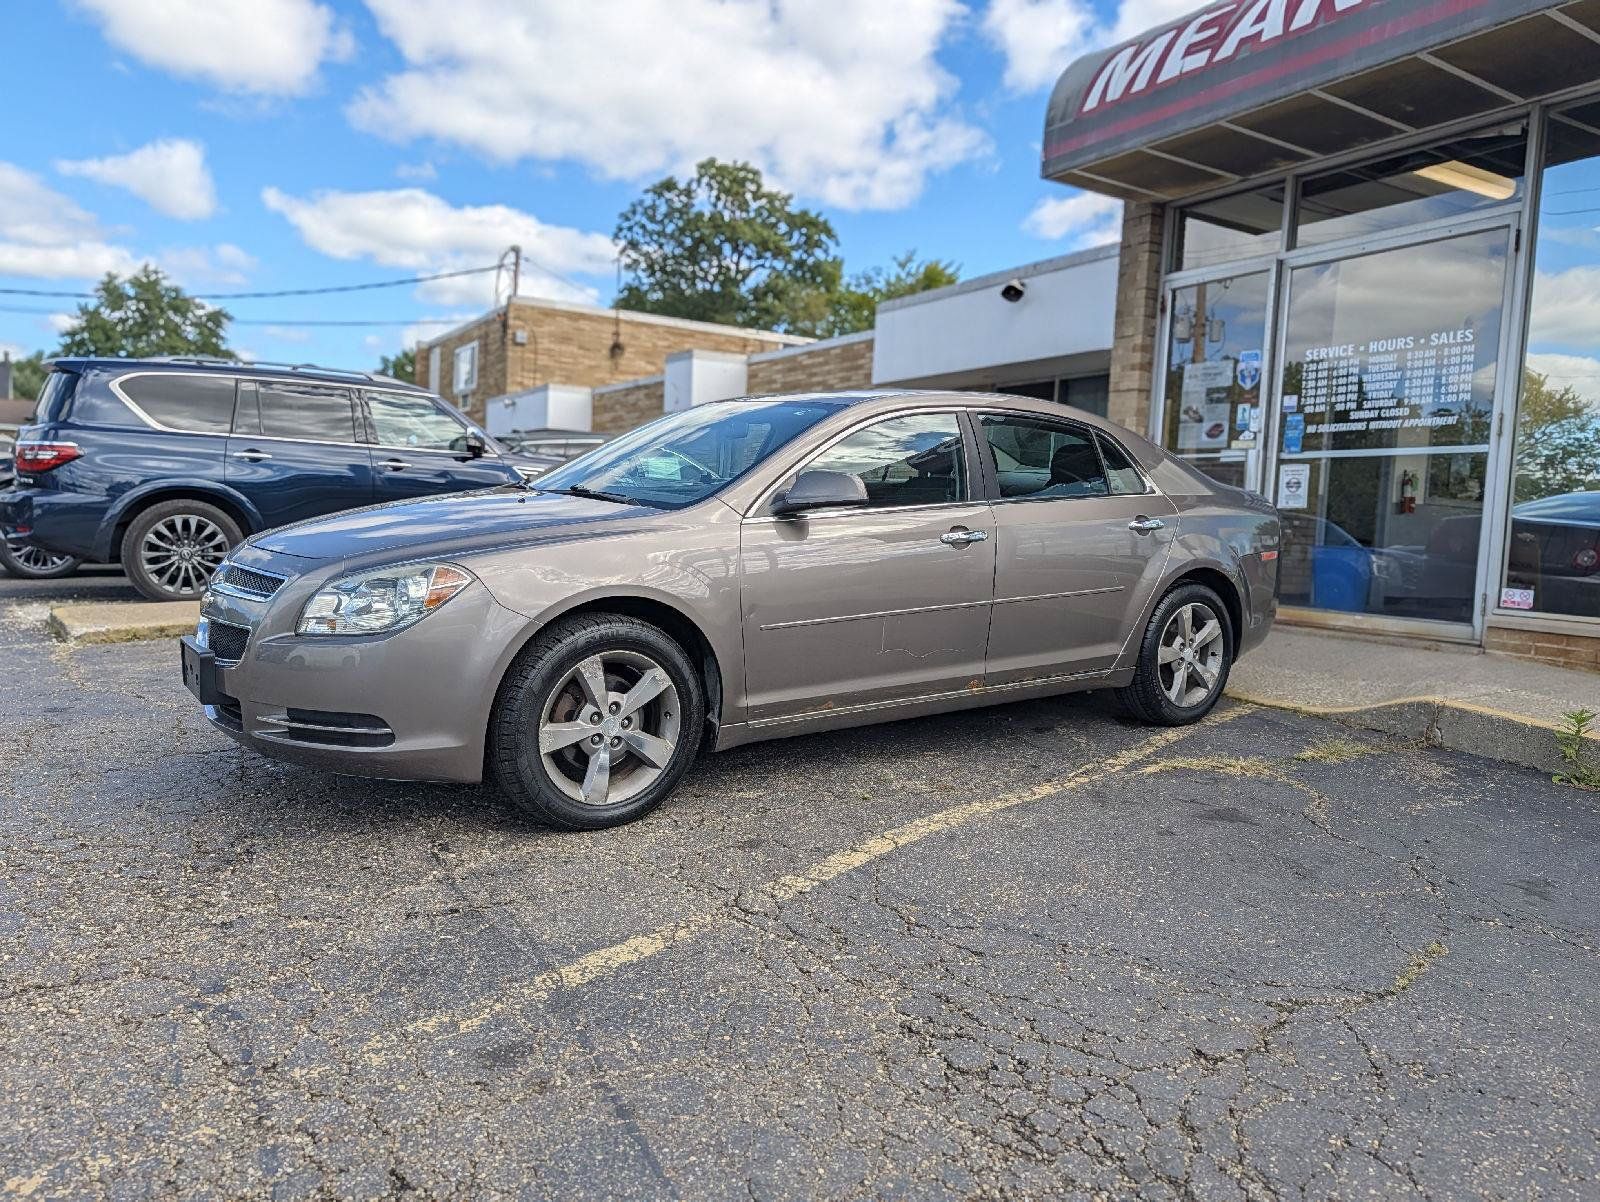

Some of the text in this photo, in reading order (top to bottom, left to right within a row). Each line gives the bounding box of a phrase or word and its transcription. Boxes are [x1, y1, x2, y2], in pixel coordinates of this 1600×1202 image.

[1305, 329, 1474, 361] SERVICE HOURS SALES
[1368, 353, 1398, 365] MONDAY
[1424, 348, 1436, 358] AM
[1462, 344, 1475, 353] PM
[1362, 371, 1402, 382] WEDNESDAY
[1423, 367, 1435, 376] AM
[1442, 364, 1460, 375] 6:00
[1461, 363, 1473, 373] PM
[1368, 362, 1398, 373] TUESDAY
[1424, 358, 1436, 367] AM
[1443, 355, 1460, 365] 6:00
[1461, 353, 1474, 363] PM
[1363, 380, 1398, 392] THURSDAY
[1422, 376, 1434, 386] AM
[1460, 372, 1472, 382] PM
[1368, 389, 1393, 400] FRIDAY
[1421, 386, 1434, 395] AM
[1441, 383, 1459, 394] 6:00
[1460, 382, 1472, 392] PM
[1363, 398, 1398, 409] SATURDAY
[1421, 394, 1433, 404] AM
[1440, 393, 1457, 403] 3:00
[1459, 391, 1472, 401] PM
[1349, 406, 1410, 420] SUNDAY CLOSED
[1368, 419, 1402, 430] WITHOUT
[1402, 415, 1459, 428] APPOINTMENT
